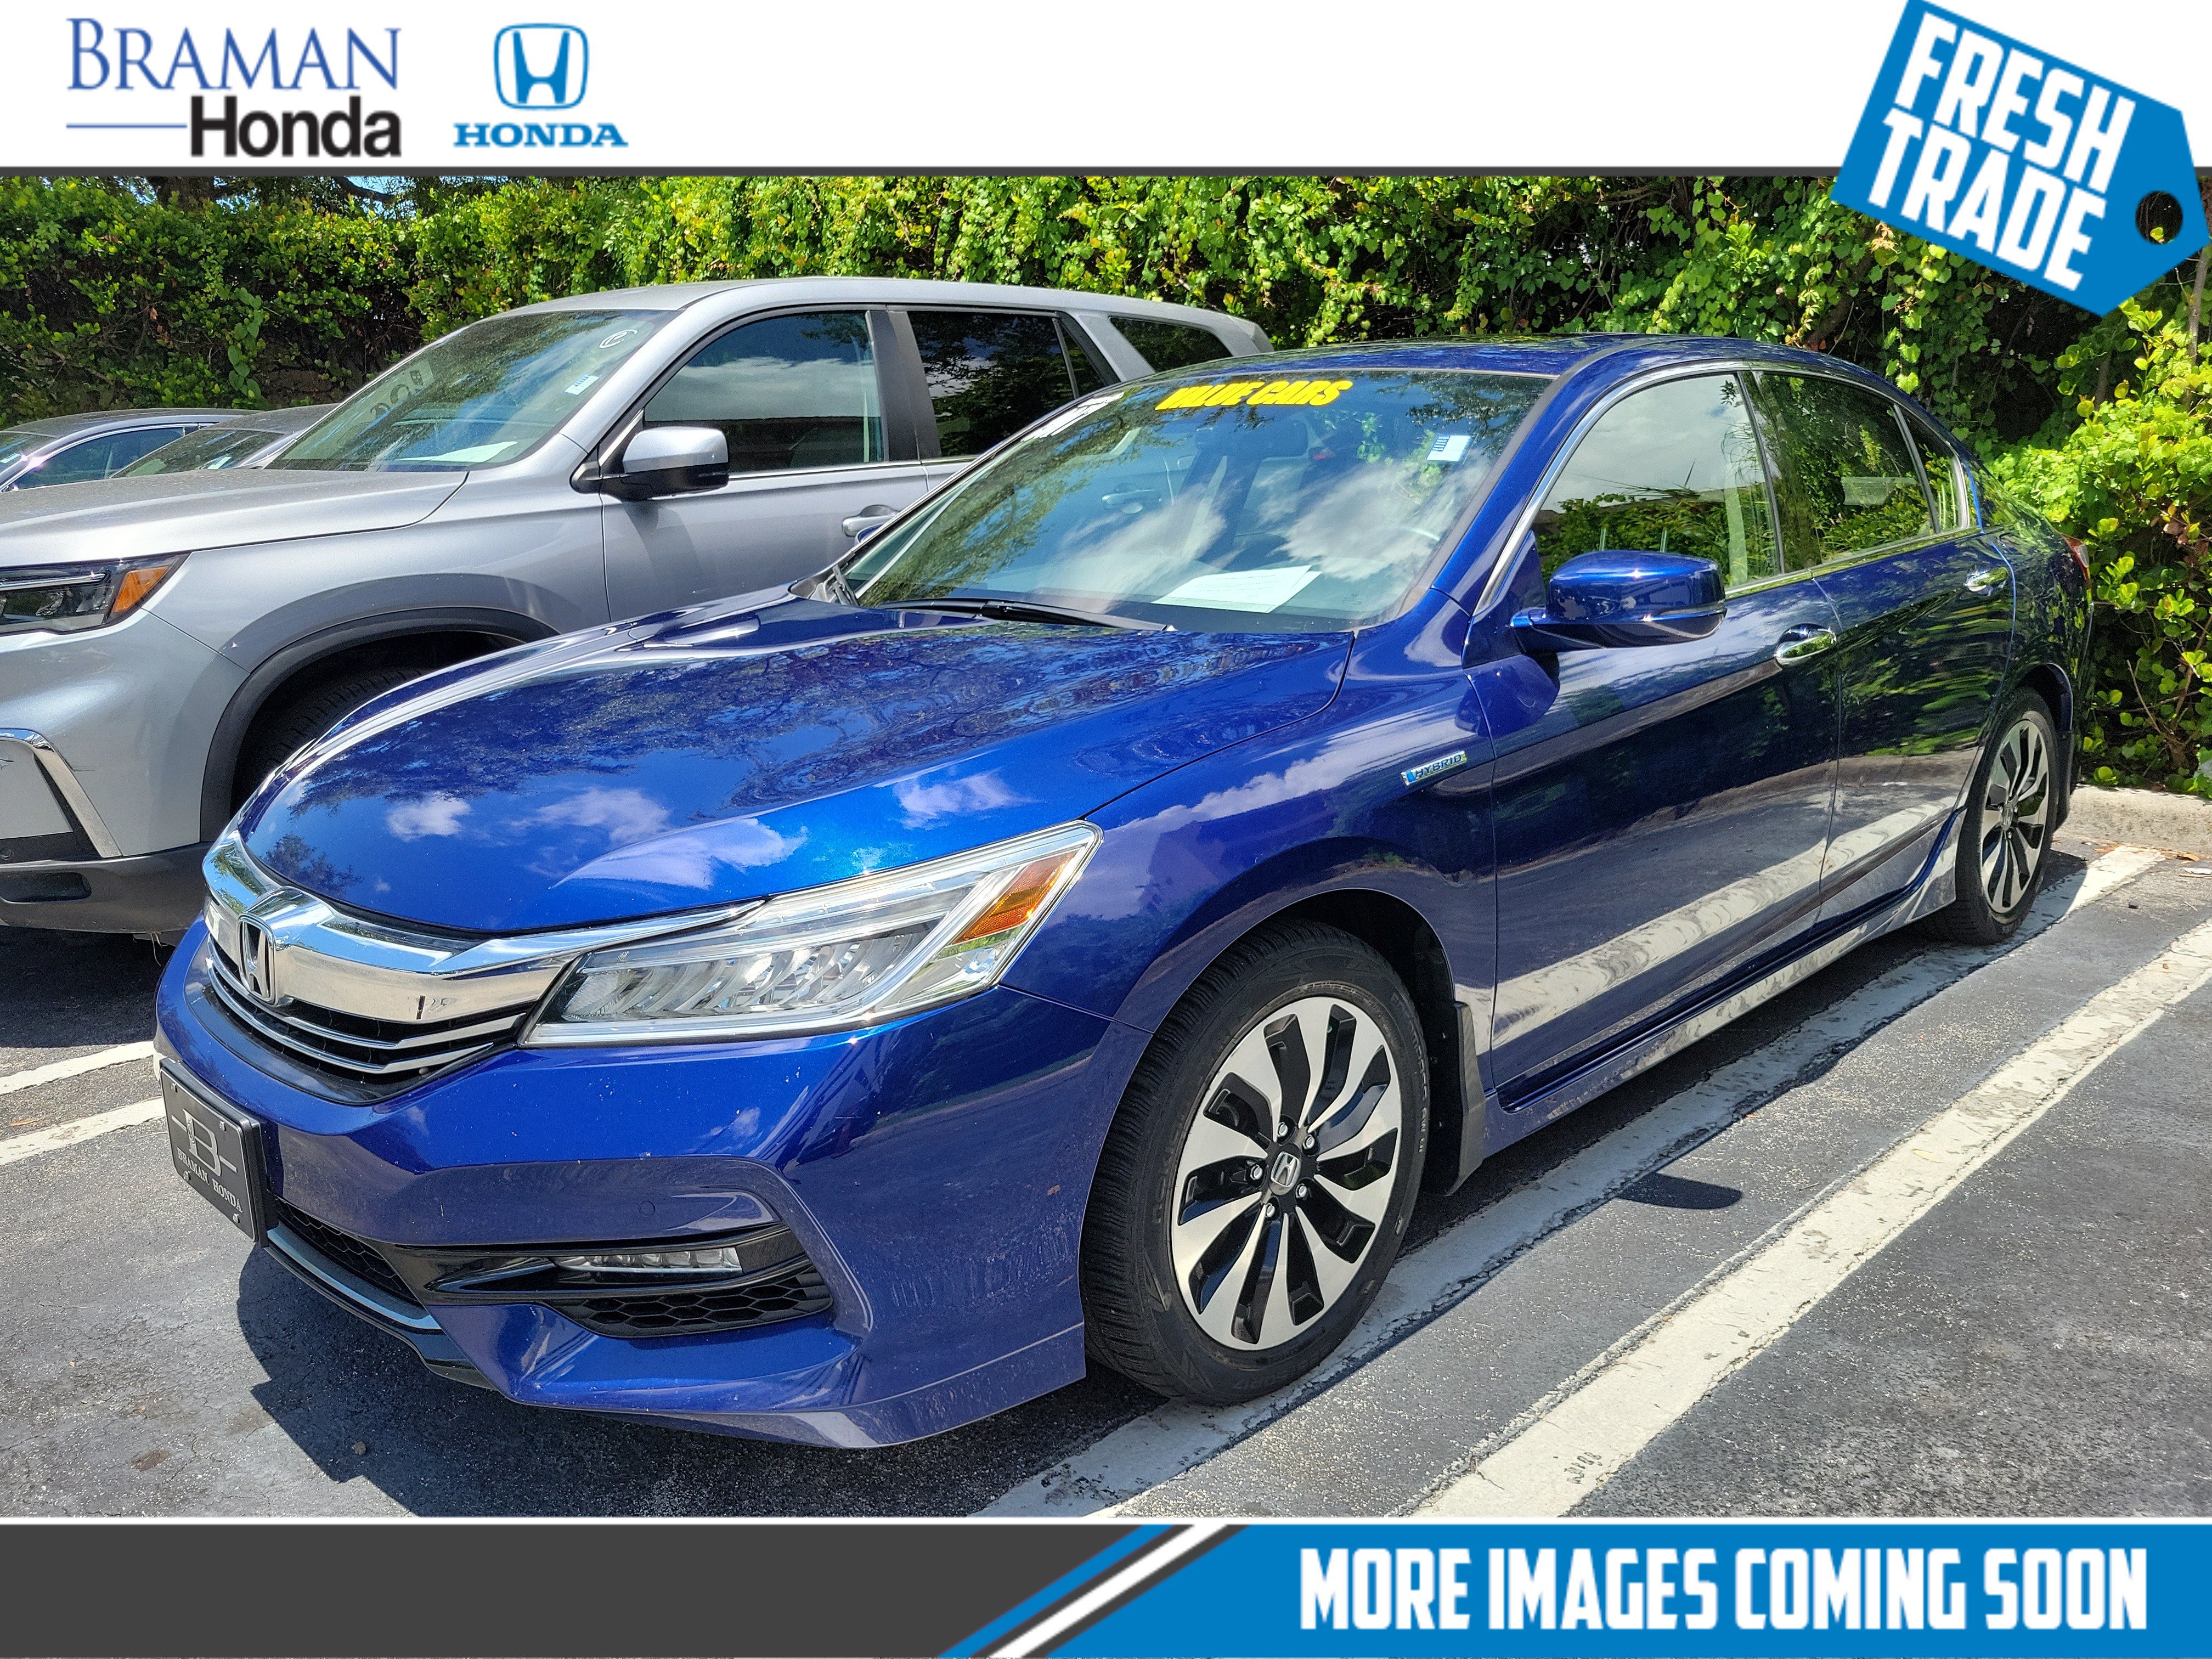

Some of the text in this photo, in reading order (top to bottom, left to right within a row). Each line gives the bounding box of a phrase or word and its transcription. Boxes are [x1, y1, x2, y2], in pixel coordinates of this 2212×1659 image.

[1246, 380, 1353, 406] CARS
[1415, 754, 1462, 777] HYBRID
[212, 1178, 243, 1213] HONDA
